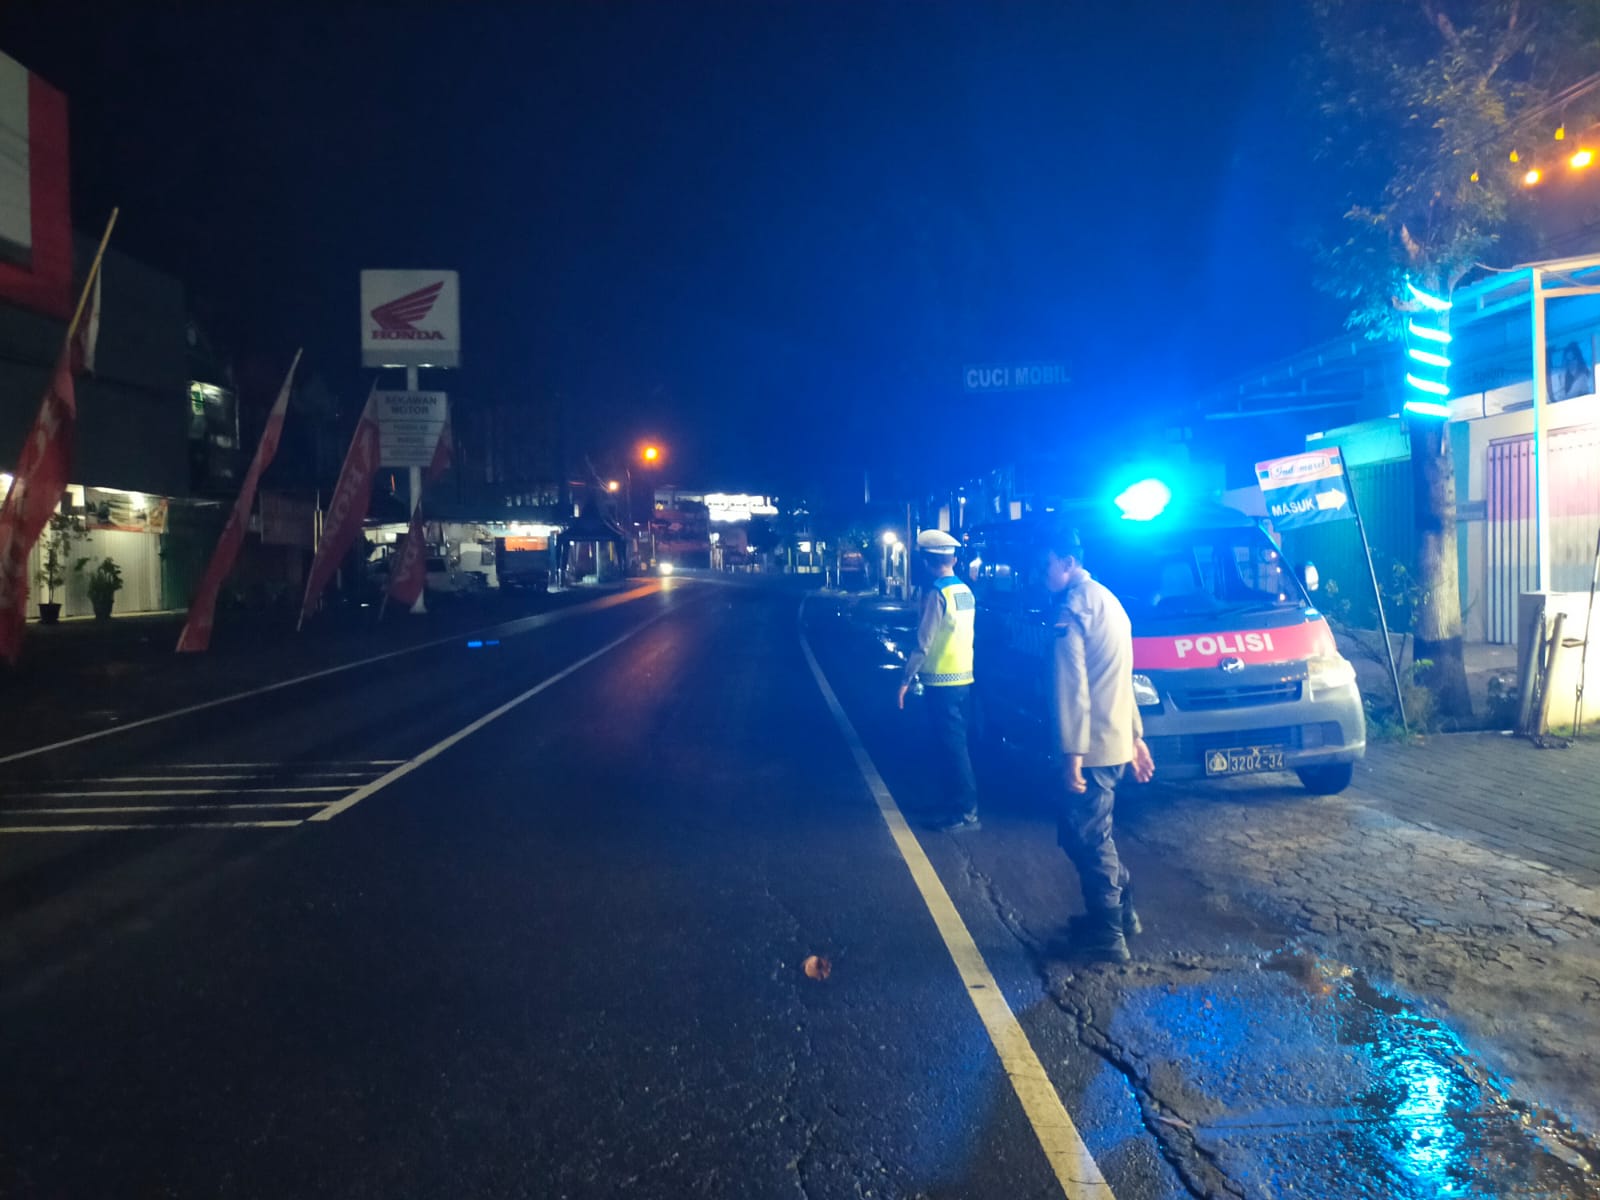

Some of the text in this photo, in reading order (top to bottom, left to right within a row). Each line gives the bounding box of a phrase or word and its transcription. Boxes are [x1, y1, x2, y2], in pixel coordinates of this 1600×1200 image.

[371, 329, 446, 341] HONDA
[966, 364, 1072, 388] CUCI MOBIL
[391, 405, 430, 415] MOTOR
[1271, 498, 1315, 517] MASUK
[1175, 633, 1274, 658] POLISI
